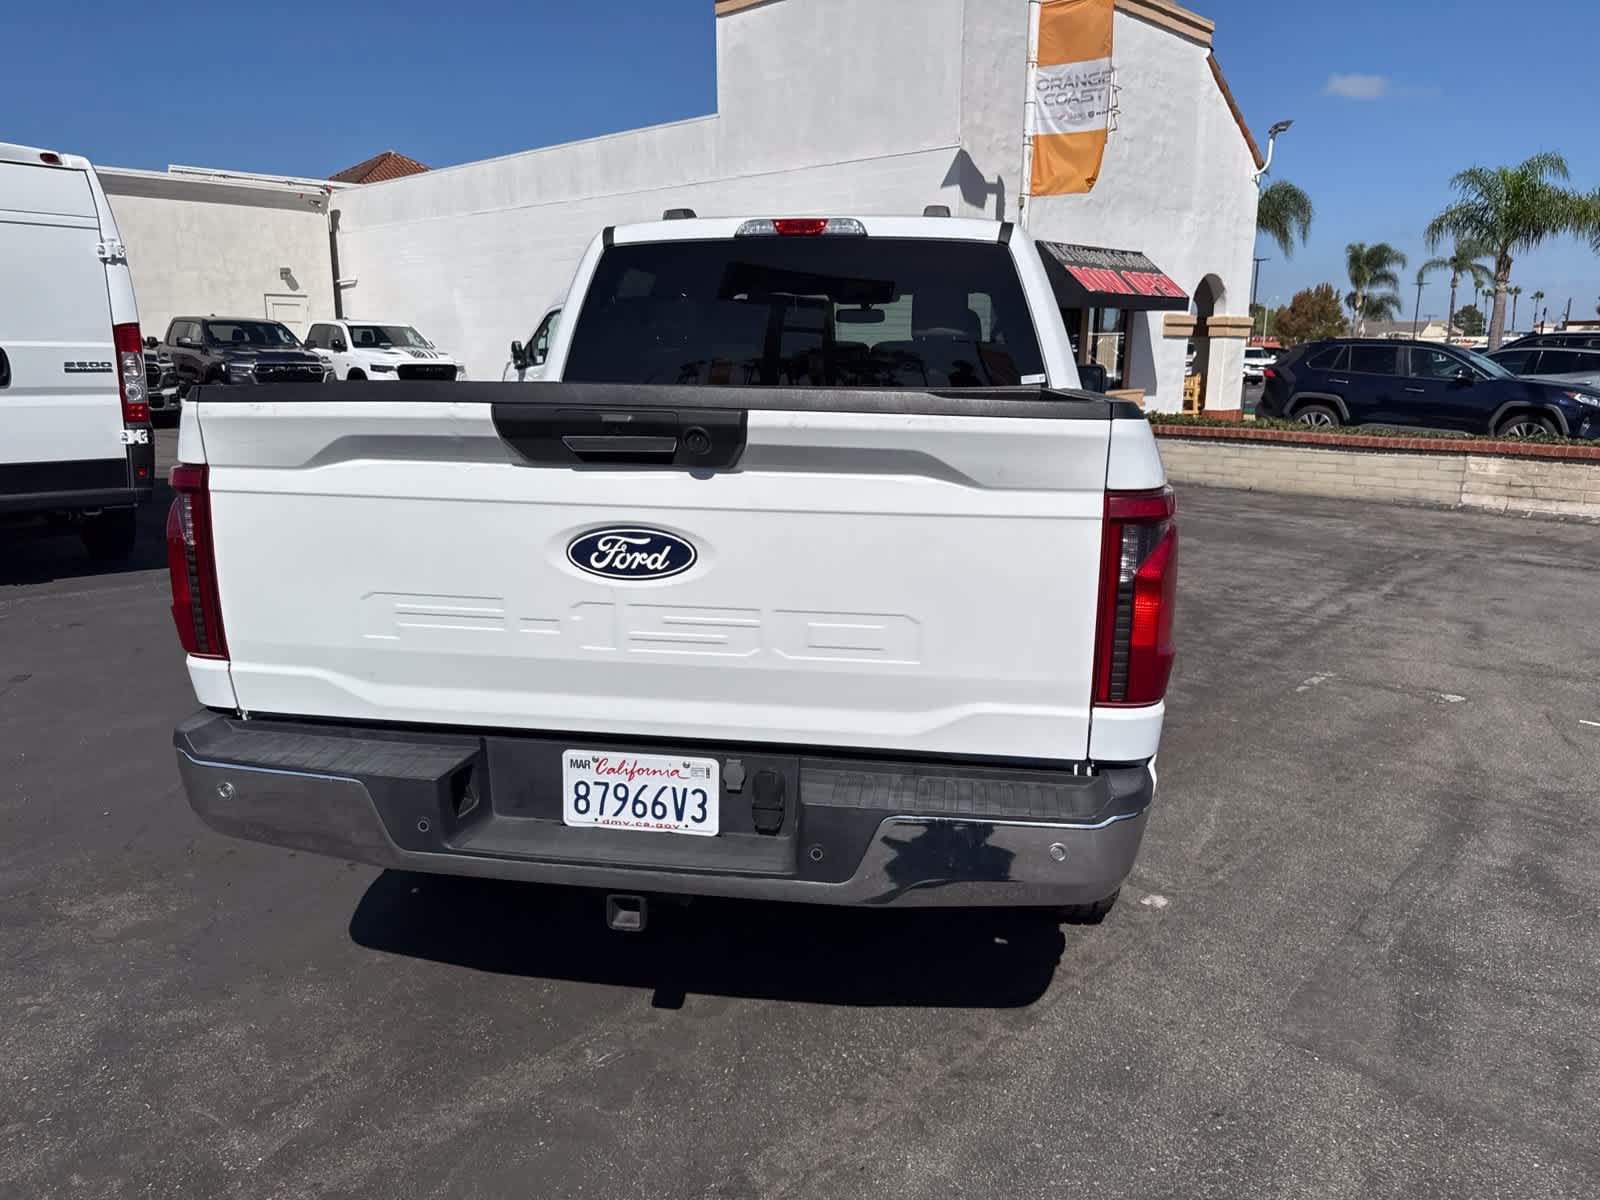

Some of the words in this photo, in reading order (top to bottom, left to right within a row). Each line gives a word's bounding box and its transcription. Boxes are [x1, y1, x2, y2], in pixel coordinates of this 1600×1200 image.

[1036, 70, 1112, 91] ORANGE
[1043, 87, 1105, 106] COAST
[590, 535, 672, 570] Ford
[361, 591, 921, 666] F-150
[570, 758, 591, 770] MAR
[595, 757, 690, 782] California
[574, 780, 708, 824] 87966V3
[602, 818, 681, 830] dmv.ca.gov
